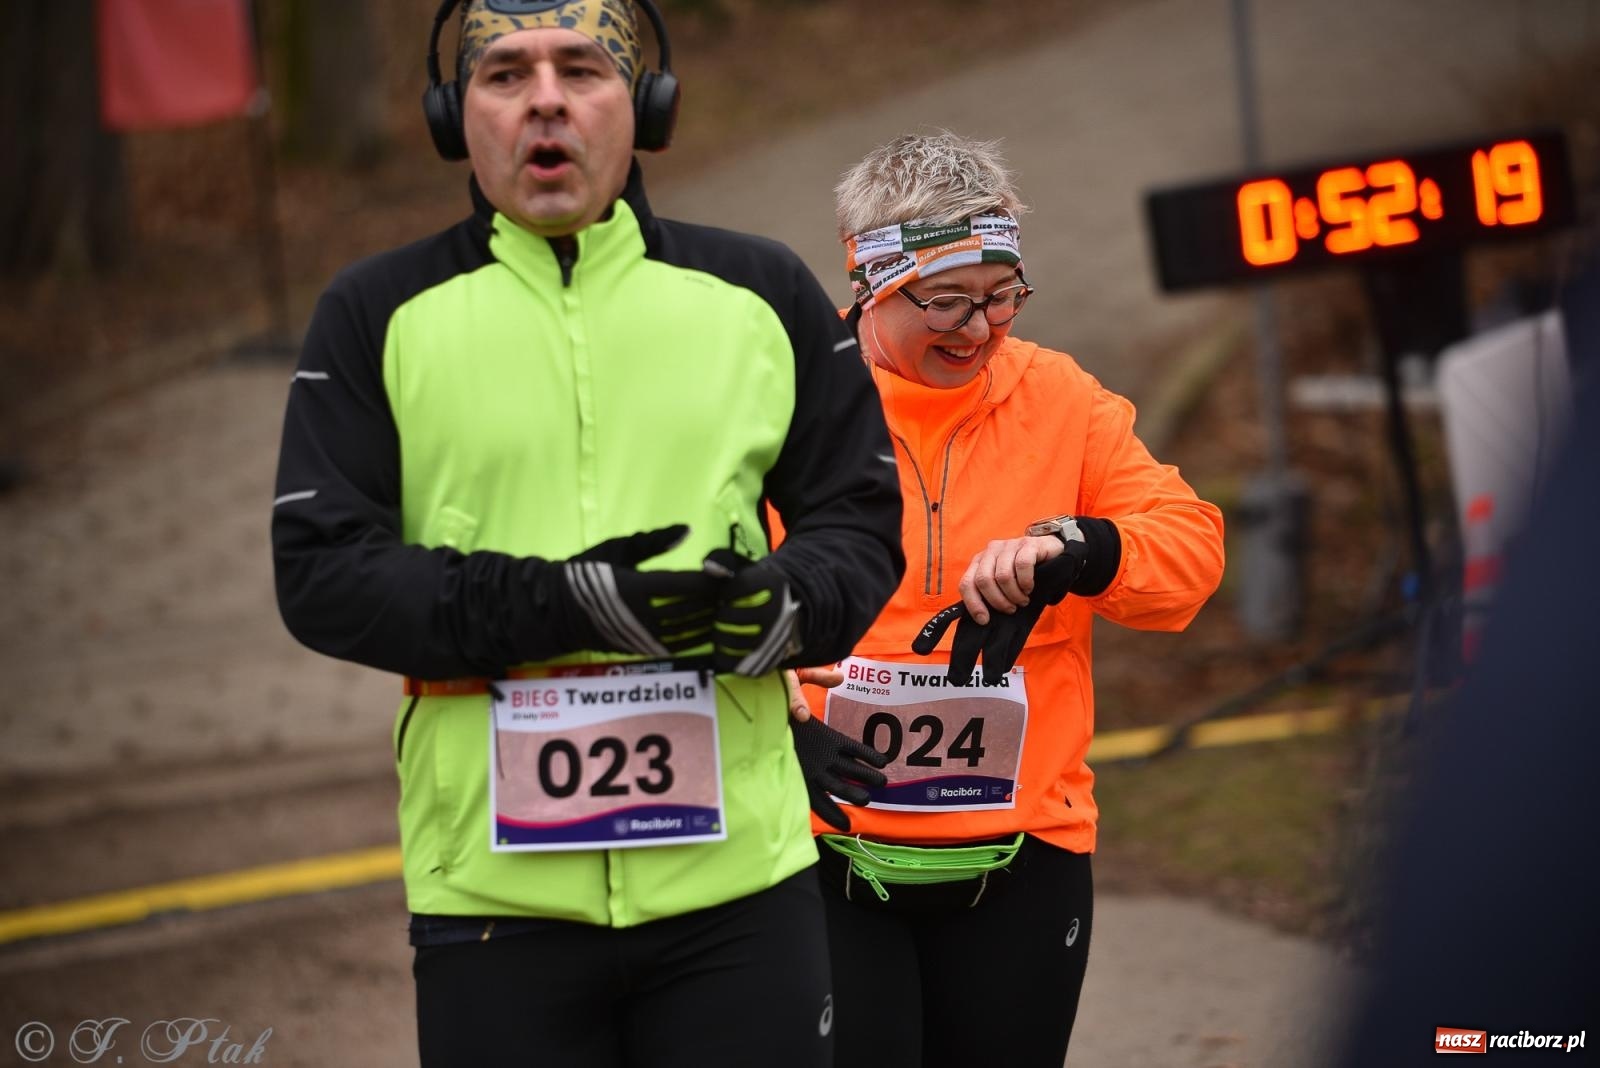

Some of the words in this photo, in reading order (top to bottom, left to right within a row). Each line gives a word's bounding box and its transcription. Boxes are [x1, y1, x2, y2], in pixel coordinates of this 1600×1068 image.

[849, 664, 892, 685] BIEG
[511, 689, 559, 708] BIEG
[565, 682, 696, 705] Twardziela
[846, 683, 855, 691] 23
[855, 683, 871, 695] luty
[872, 687, 890, 696] 2025
[862, 711, 985, 768] 024
[538, 733, 674, 799] 023
[940, 786, 982, 798] Racibórz
